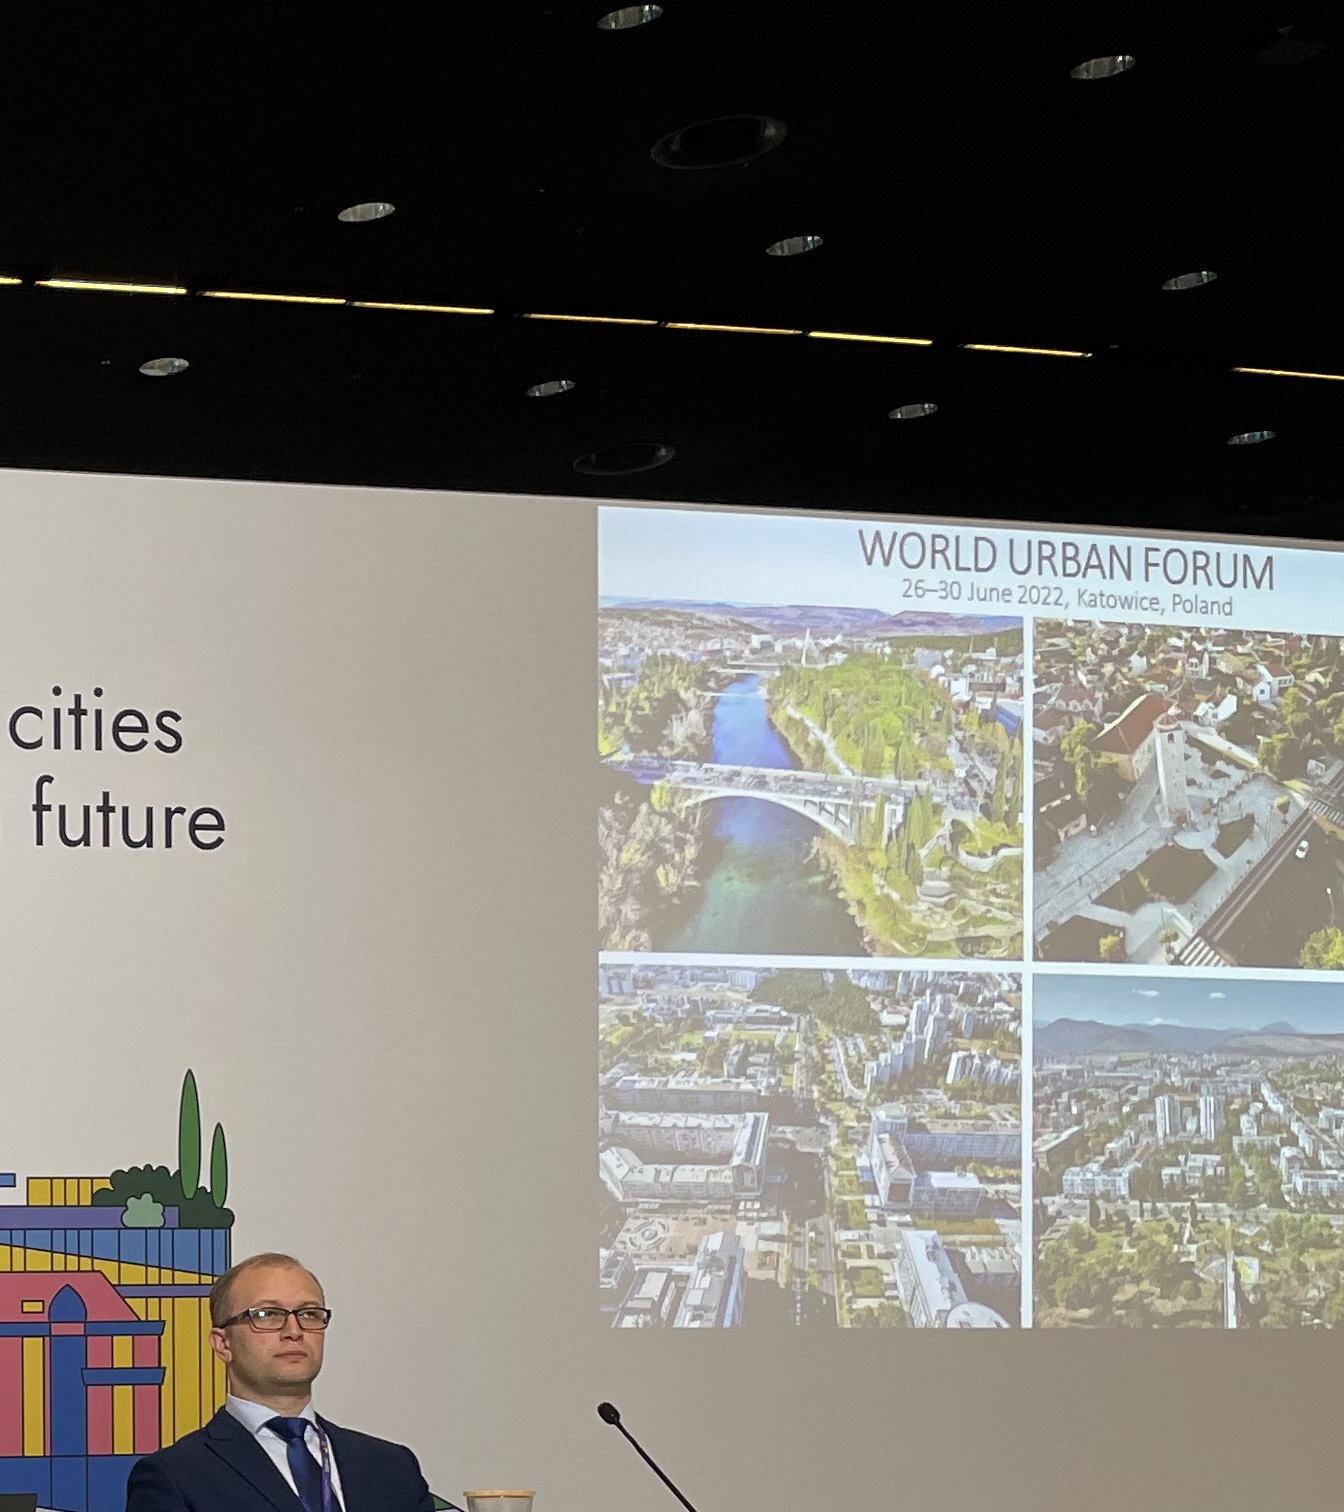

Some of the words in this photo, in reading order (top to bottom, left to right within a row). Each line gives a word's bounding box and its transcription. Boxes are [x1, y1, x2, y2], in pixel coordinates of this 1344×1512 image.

[858, 529, 997, 573] WORLD
[1008, 538, 1132, 582] URBAN
[1144, 546, 1274, 591] FORUM
[967, 581, 1013, 604] June
[1017, 584, 1070, 610] 2022,
[1077, 587, 1165, 616] Katowice,
[1172, 593, 1233, 617] Poland
[8, 685, 183, 754] cities
[31, 774, 226, 851] future
